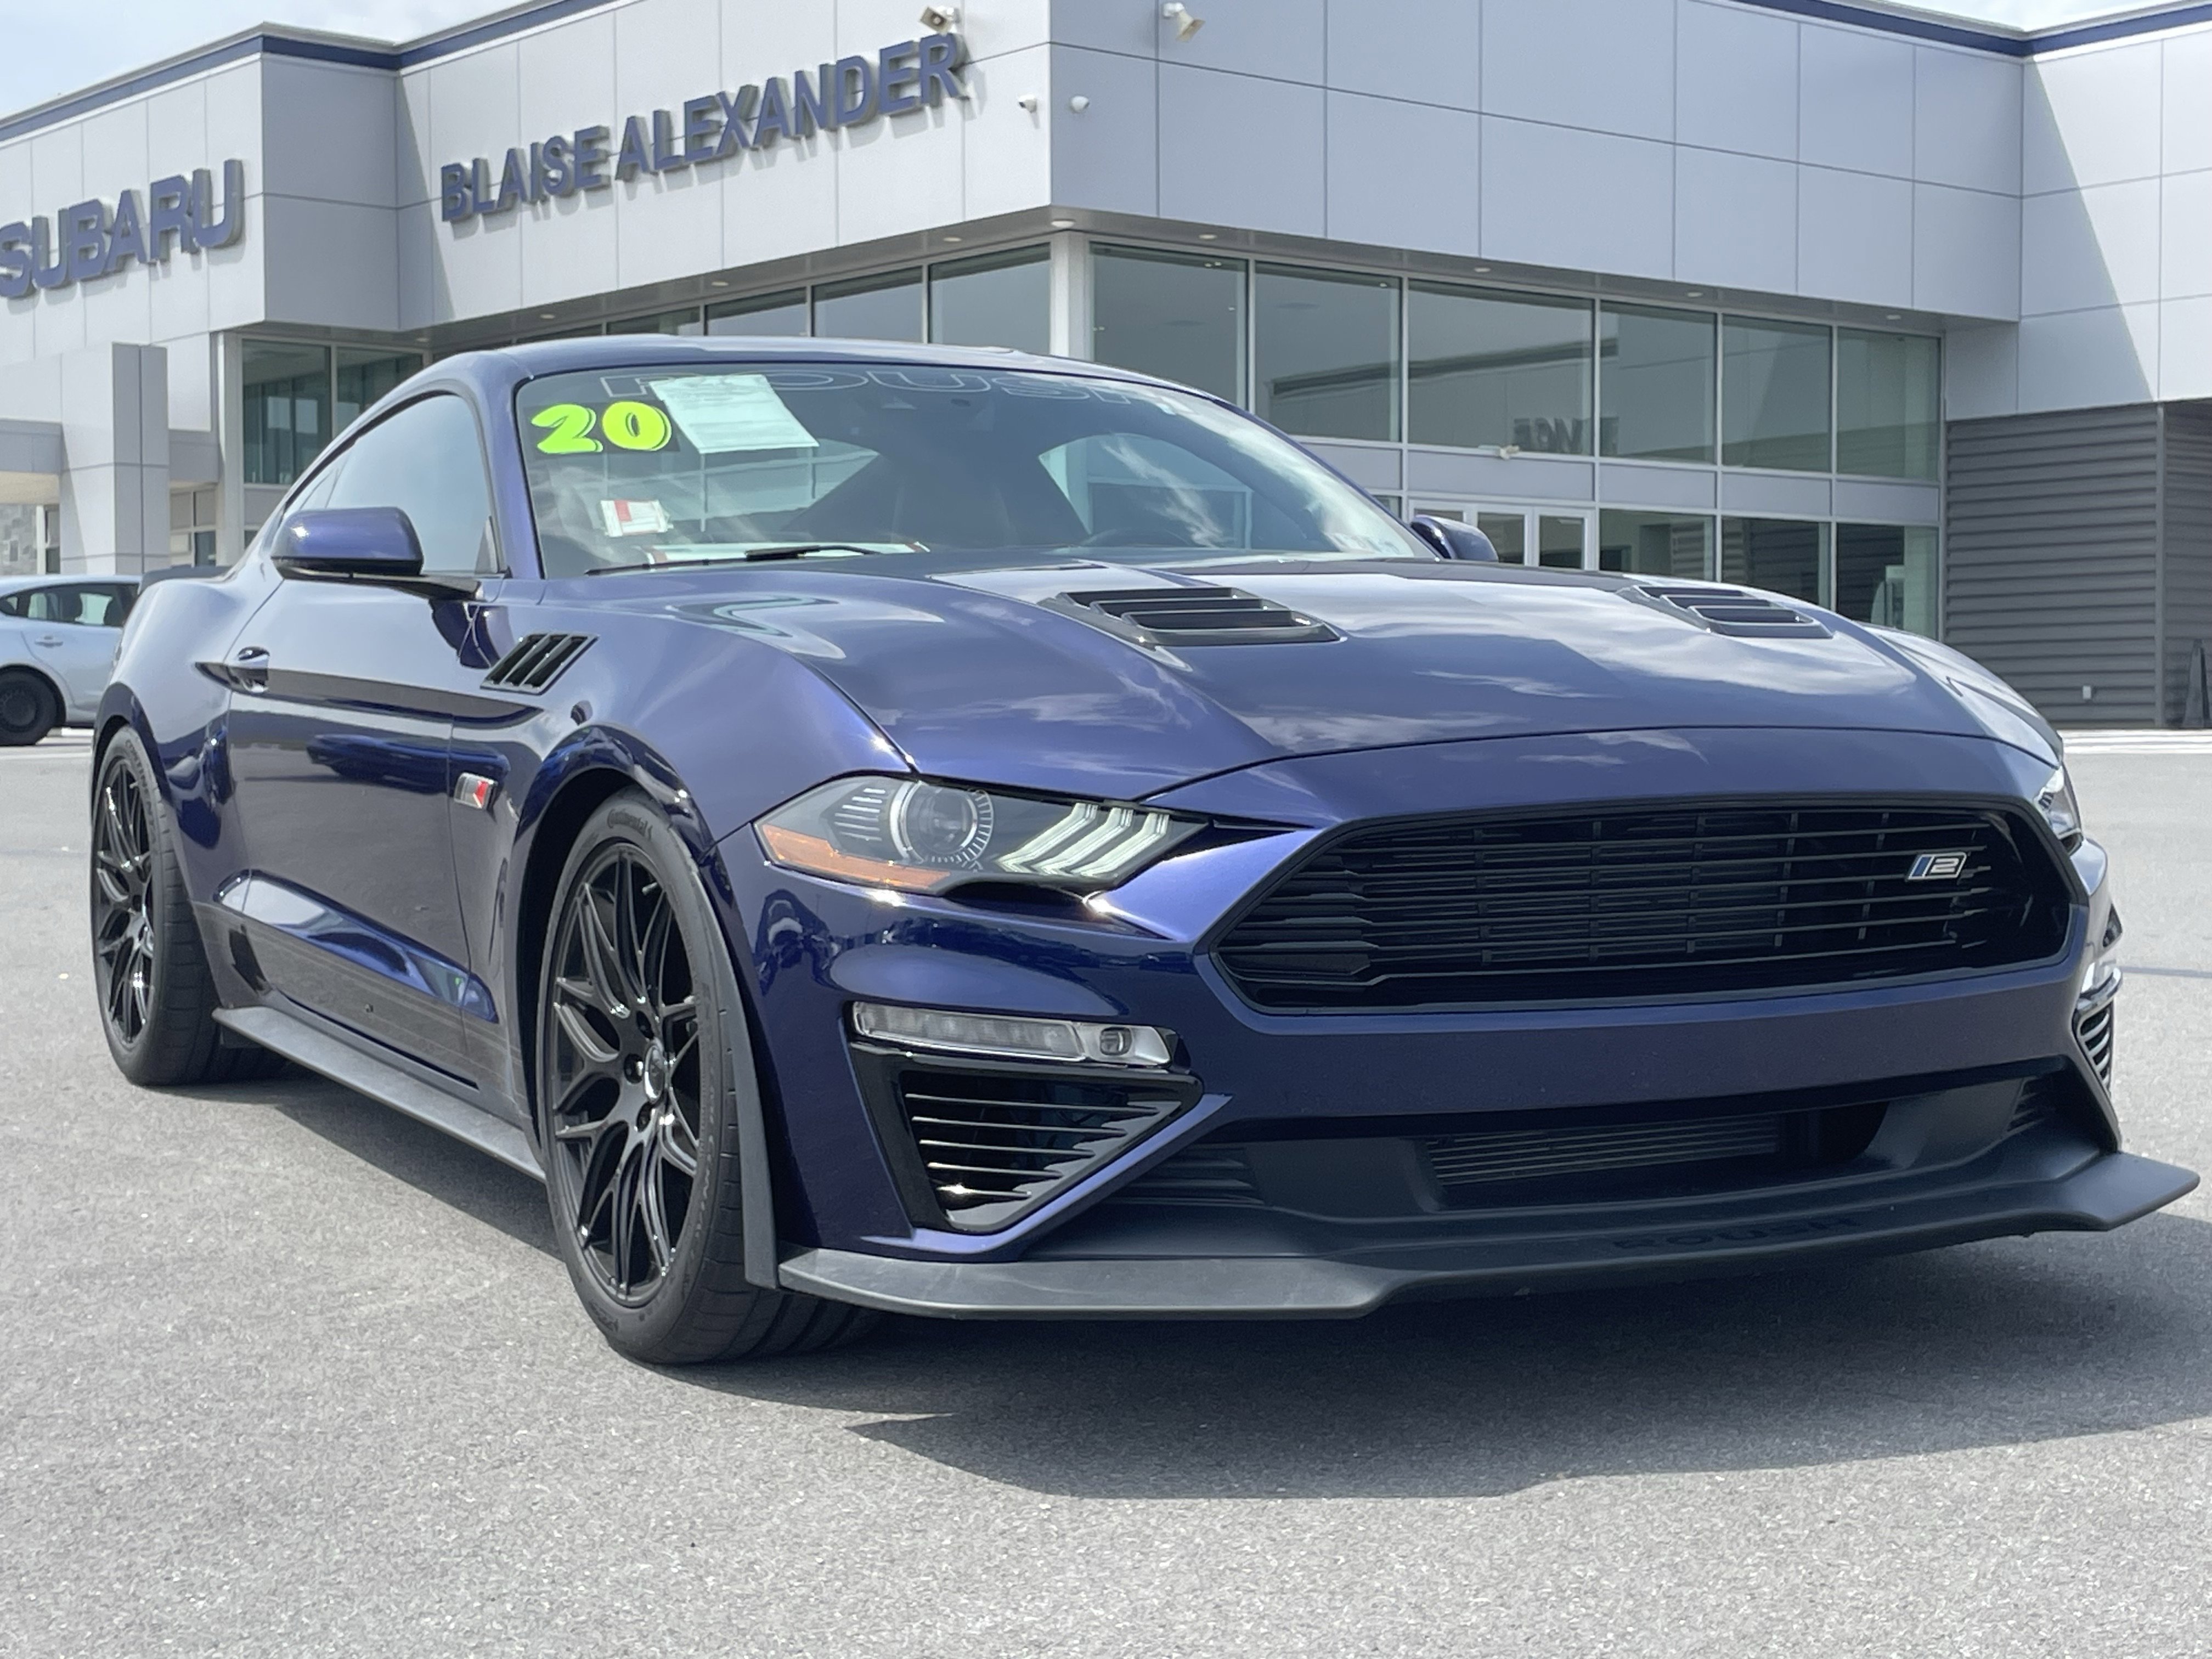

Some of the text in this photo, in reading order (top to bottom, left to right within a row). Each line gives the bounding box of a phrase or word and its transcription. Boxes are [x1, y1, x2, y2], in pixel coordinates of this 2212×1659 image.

[442, 33, 970, 222] BLAISE ALEXANDER
[0, 158, 246, 300] SUBARU
[531, 401, 672, 454] 20
